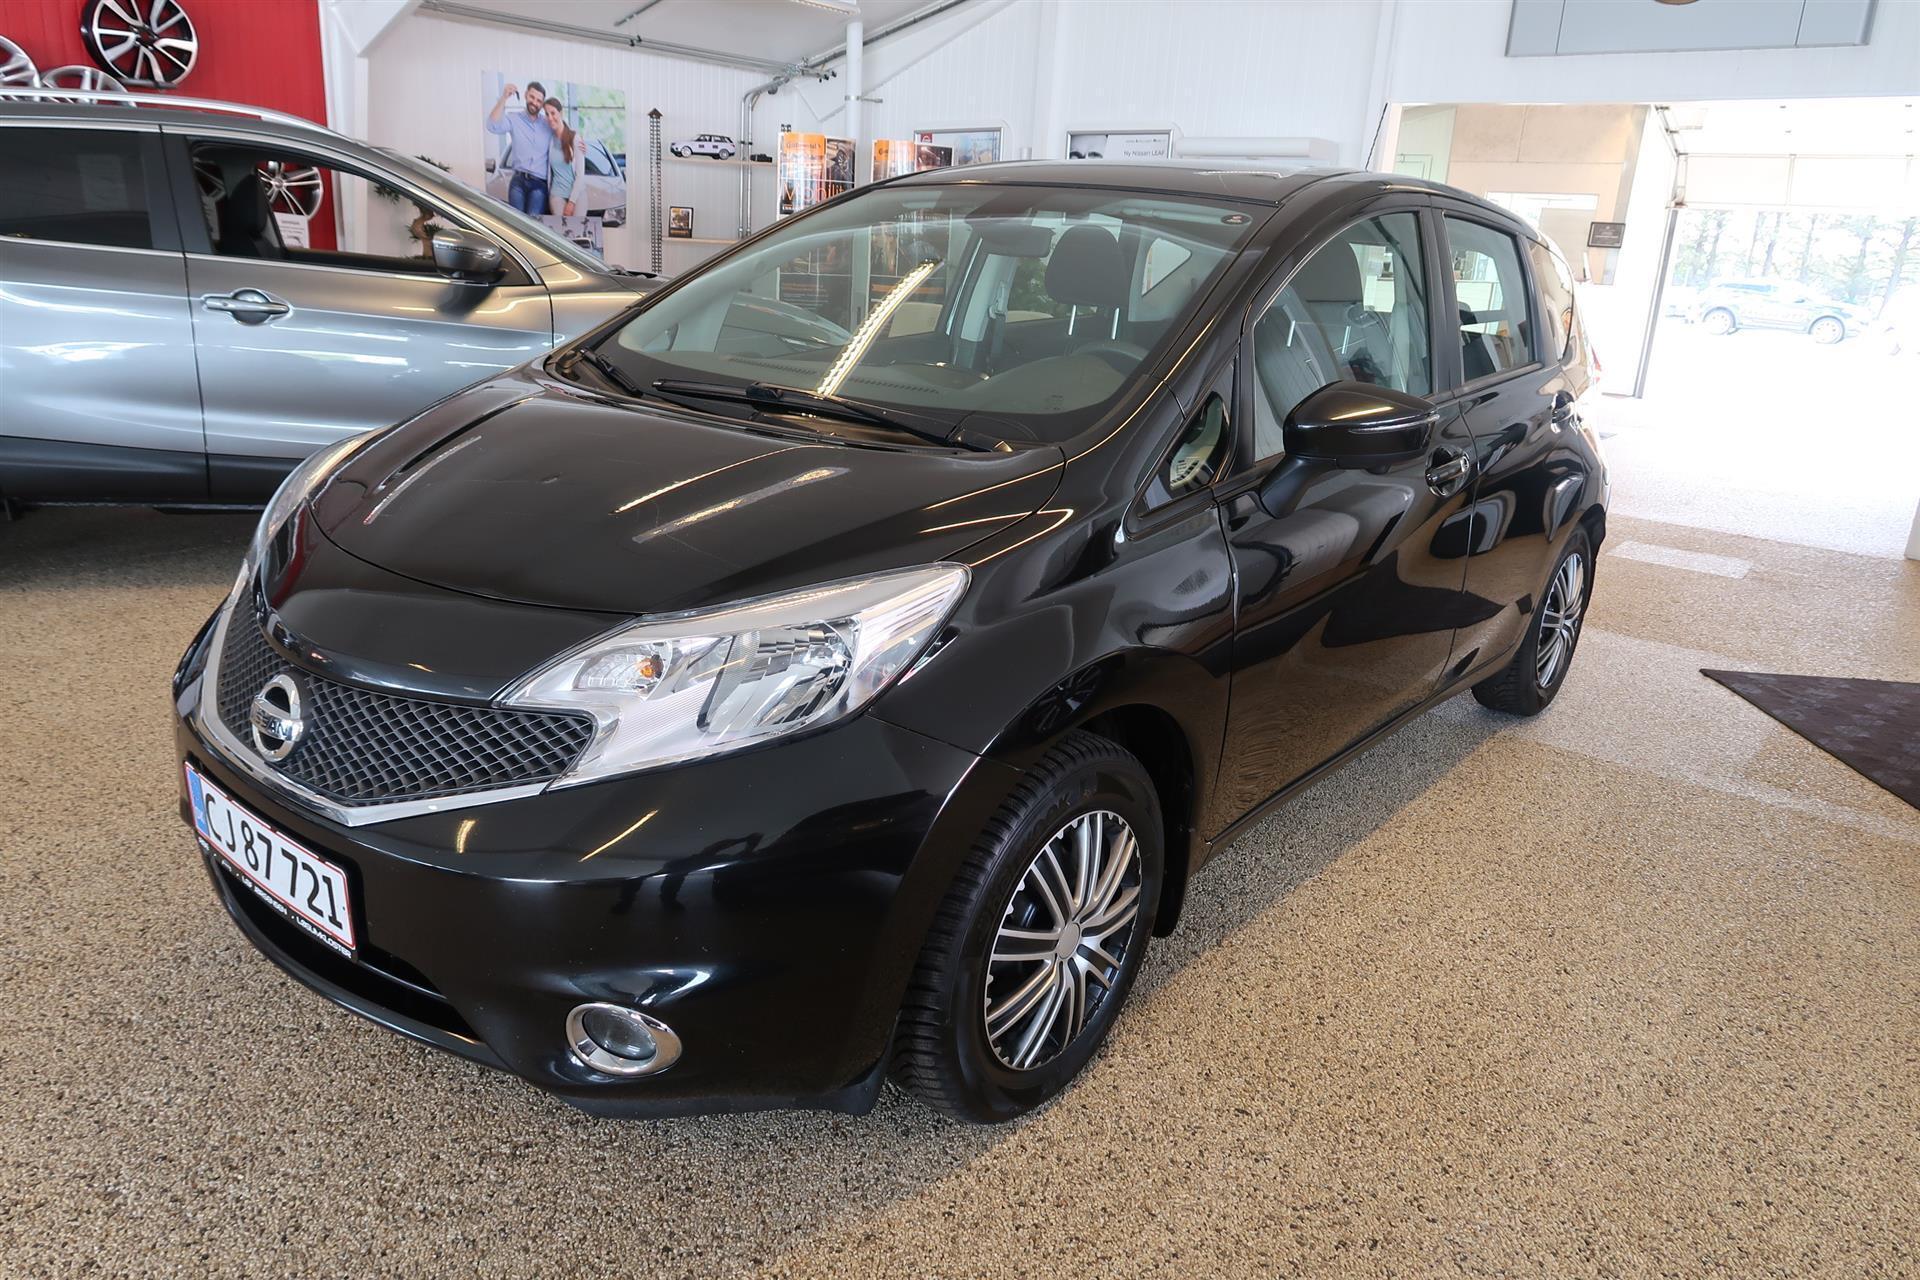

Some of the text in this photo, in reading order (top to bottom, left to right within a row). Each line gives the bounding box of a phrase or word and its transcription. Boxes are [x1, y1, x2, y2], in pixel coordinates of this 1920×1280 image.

[783, 181, 845, 205] Mobilit
[204, 792, 236, 853] CJ
[240, 819, 272, 881] 87
[281, 849, 343, 930] 721
